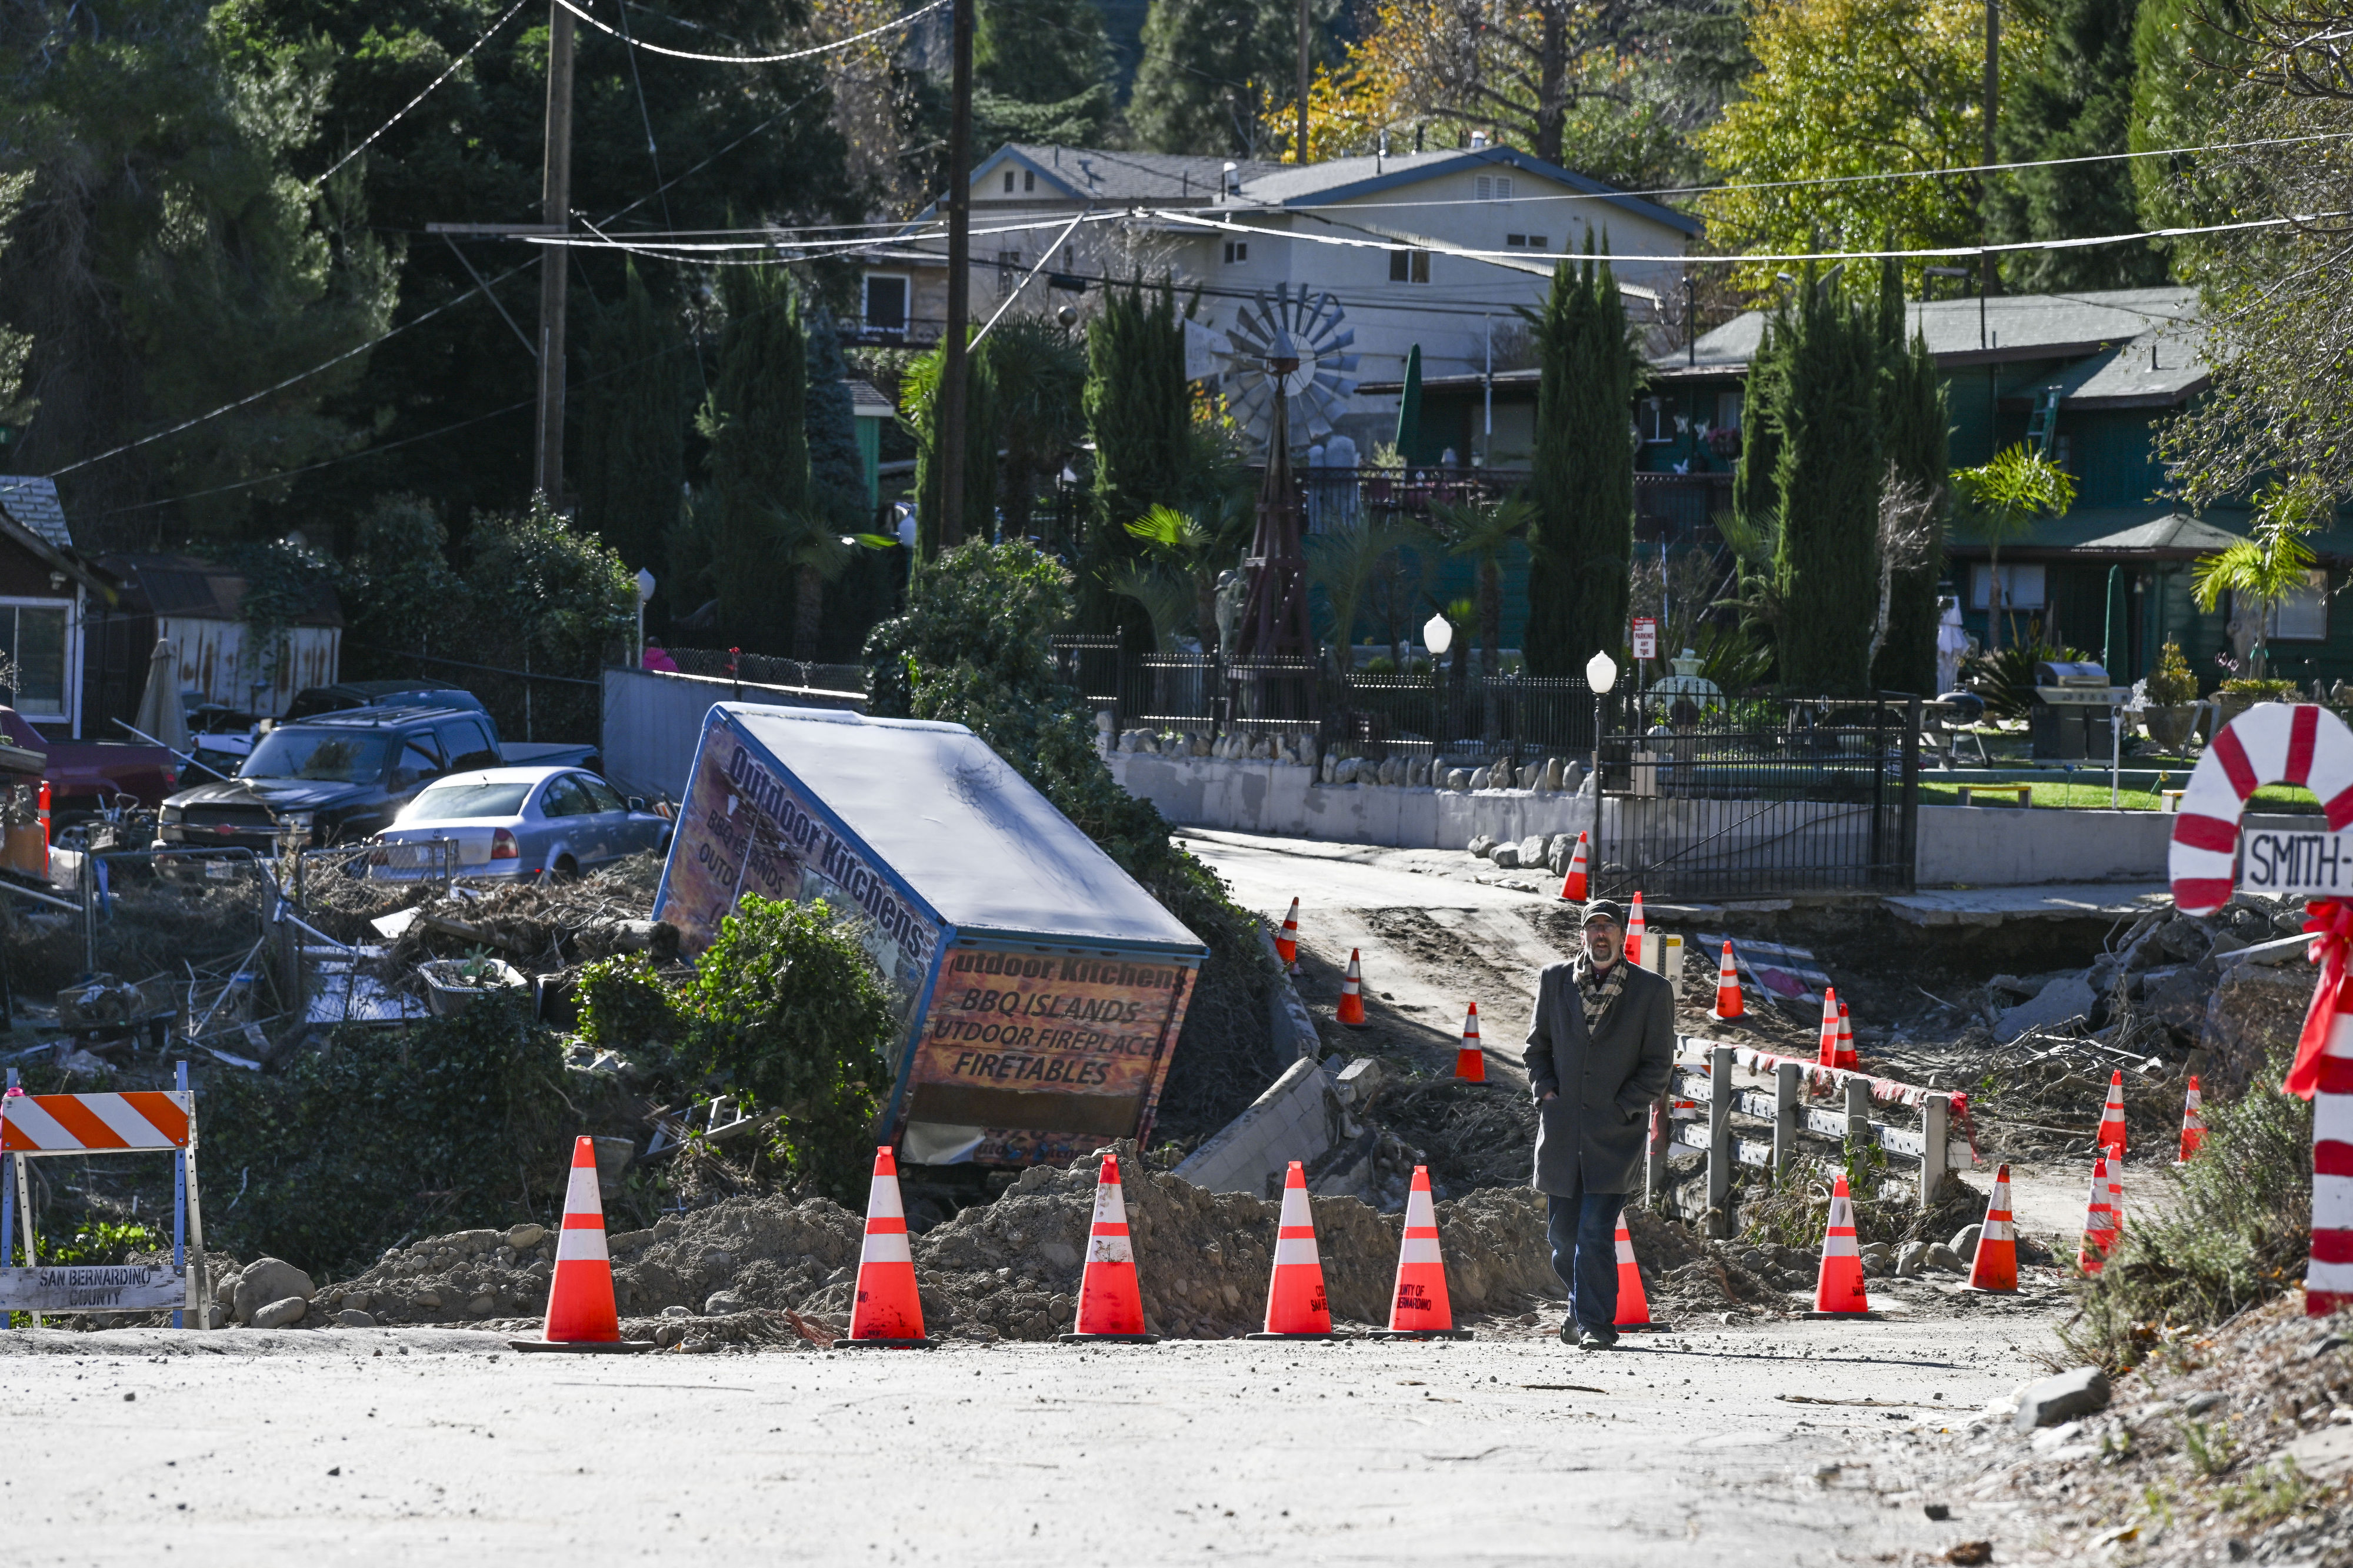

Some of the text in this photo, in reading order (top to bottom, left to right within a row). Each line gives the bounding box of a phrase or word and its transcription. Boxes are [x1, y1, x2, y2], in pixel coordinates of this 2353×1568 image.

[707, 809, 733, 849] BBQ
[729, 745, 925, 958] Outdoor Kitchens
[948, 952, 1055, 979] utdoor
[960, 988, 1141, 1024] BBQ ISLANDS
[930, 1020, 1034, 1046] UTDOOR
[953, 1052, 1111, 1086] FIRETABLES
[39, 1267, 151, 1287] SAN BERNARDINO
[69, 1288, 121, 1306] COUNTY
[1416, 1285, 1425, 1297] OF
